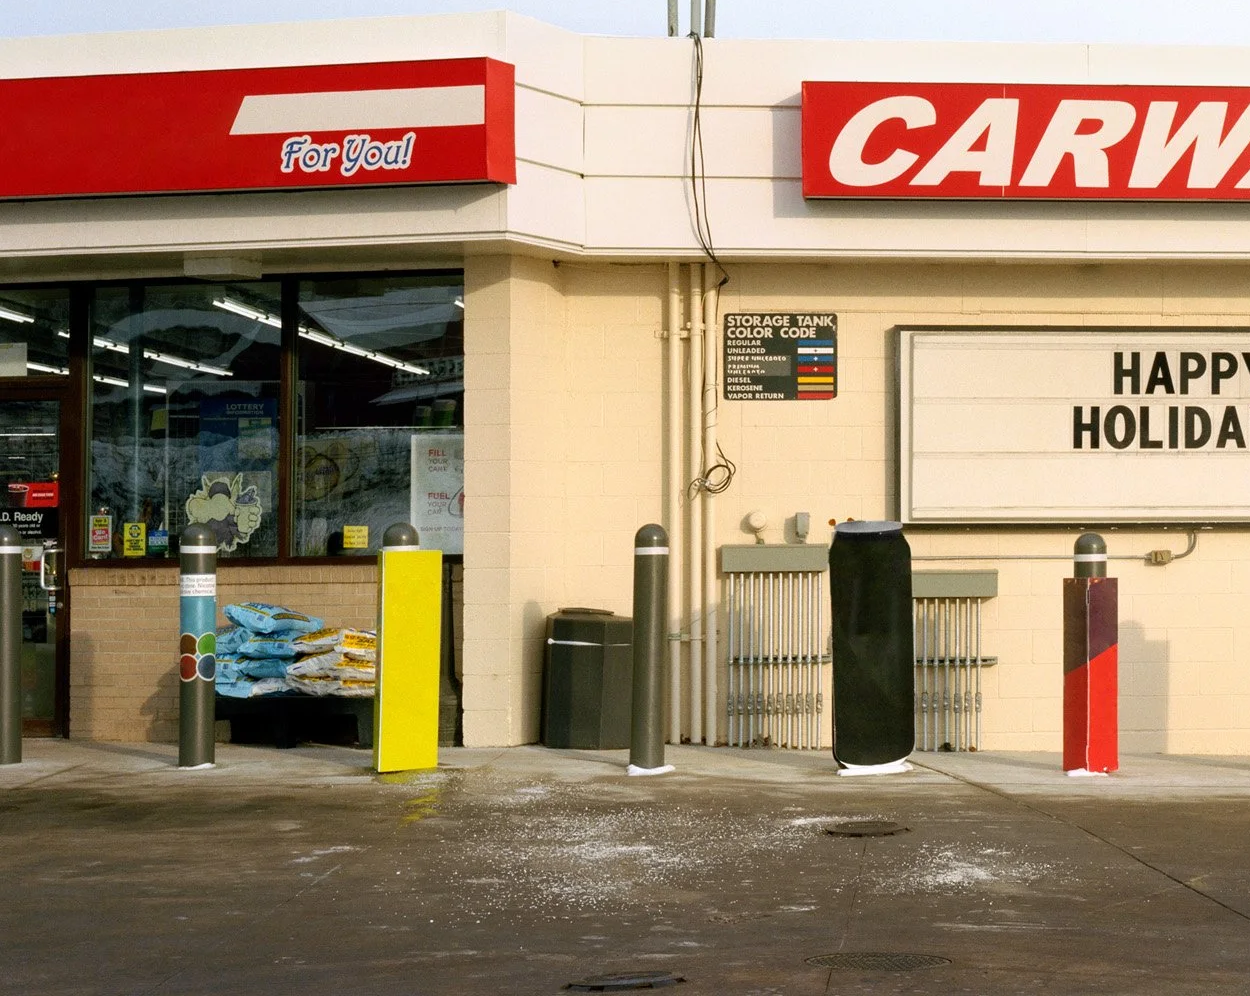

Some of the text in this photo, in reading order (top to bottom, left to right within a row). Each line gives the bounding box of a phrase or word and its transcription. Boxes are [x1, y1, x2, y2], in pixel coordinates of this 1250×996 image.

[282, 133, 415, 175] For You!
[727, 315, 833, 327] STORAGE TANK
[727, 327, 816, 339] COLOR CODE
[727, 392, 784, 400] VAPOR RETURN
[428, 449, 447, 457] FILL
[428, 492, 450, 500] FUEL
[14, 511, 43, 523] Ready
